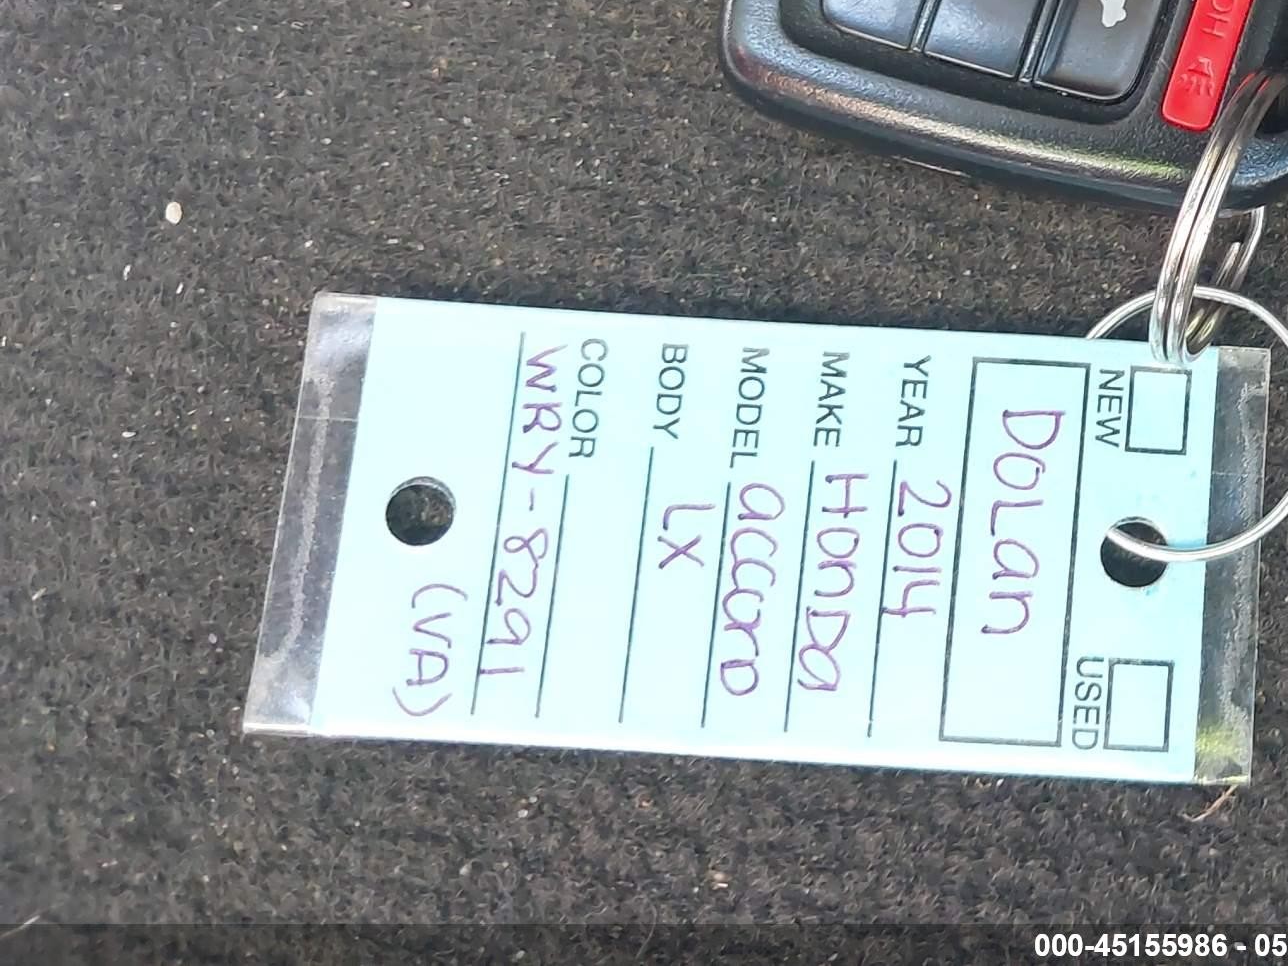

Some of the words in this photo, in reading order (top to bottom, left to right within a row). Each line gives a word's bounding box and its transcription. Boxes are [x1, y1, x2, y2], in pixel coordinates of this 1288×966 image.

[568, 338, 609, 459] COLOR
[653, 342, 689, 440] BODY
[730, 347, 770, 468] MODEL
[813, 351, 850, 448] MAKE
[896, 354, 931, 448] YEAR
[1095, 369, 1125, 448] NEW
[478, 344, 569, 676] WRY-8291
[658, 503, 716, 569] LX
[882, 480, 952, 618] 2014
[392, 583, 468, 717] (VA)
[1072, 655, 1104, 751] USED
